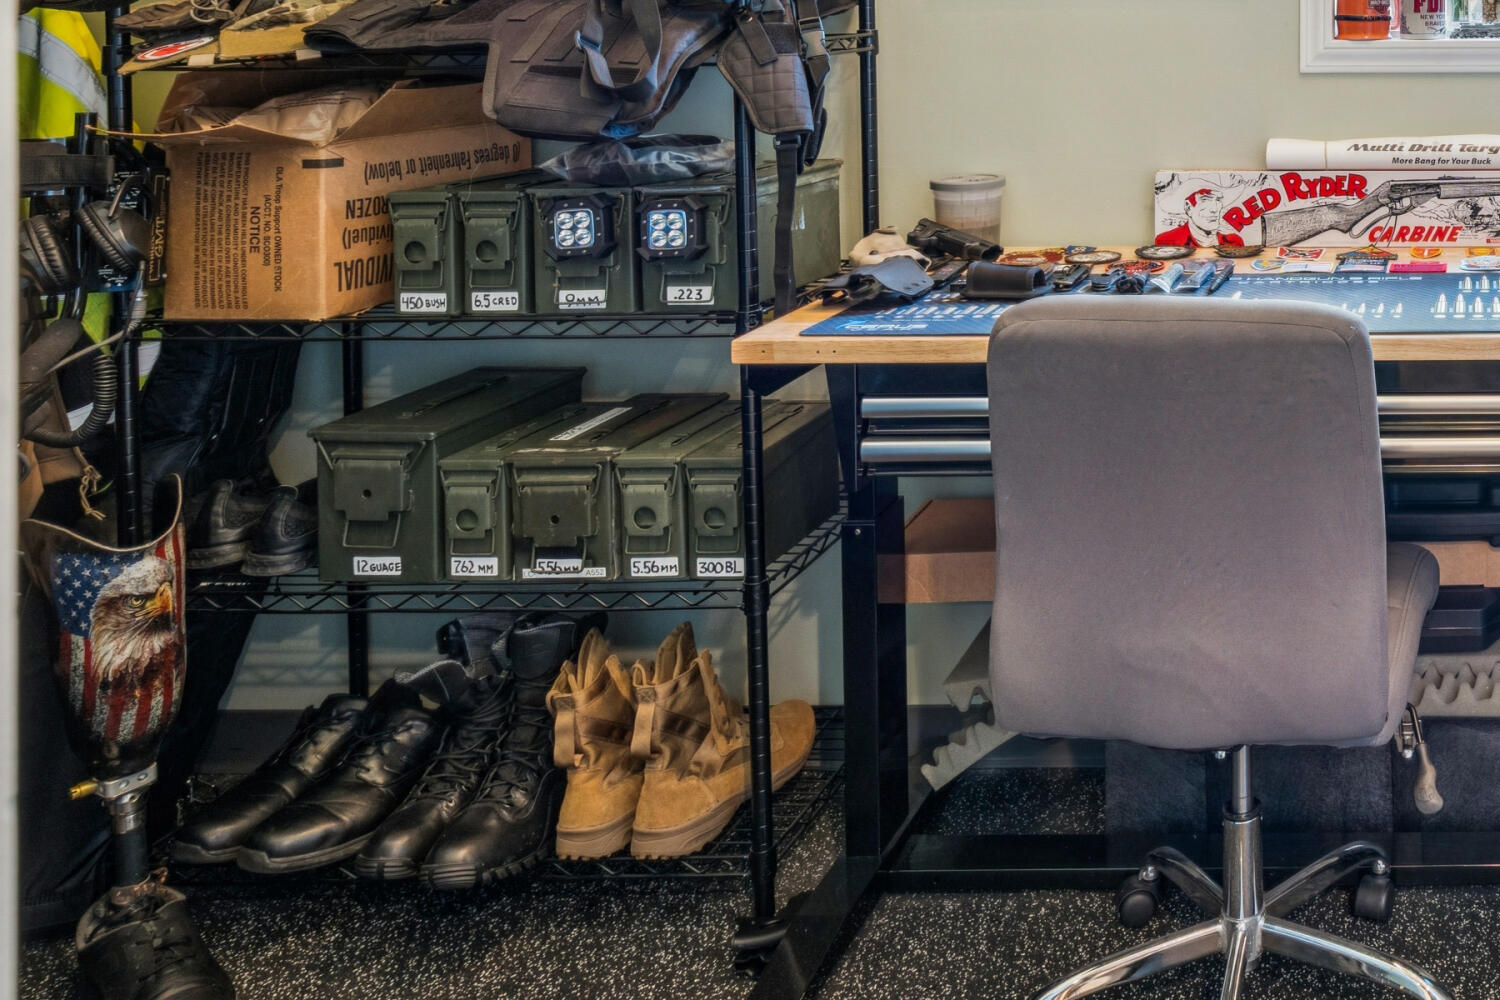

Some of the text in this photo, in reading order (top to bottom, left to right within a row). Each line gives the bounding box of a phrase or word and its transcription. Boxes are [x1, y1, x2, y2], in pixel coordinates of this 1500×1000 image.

[473, 143, 510, 164] degrees
[1347, 143, 1404, 152] Multi
[1408, 143, 1453, 152] Drill
[405, 162, 416, 175] or
[420, 150, 471, 176] Fahrenheit
[1415, 157, 1436, 165] Bang
[364, 161, 402, 185] below)
[274, 184, 283, 204] Troop
[1223, 172, 1368, 232] RED RYDER
[263, 194, 271, 233] (ACCT. NO.
[274, 205, 282, 234] Support
[155, 216, 165, 258] GMT
[250, 206, 260, 254] NOTICE
[1368, 225, 1463, 243] CARBINE
[274, 236, 282, 264] OWNED
[274, 266, 282, 292] STOCK
[402, 296, 446, 309] 450 BUSH
[474, 293, 517, 308] 6.5 CRED
[673, 288, 703, 300] .223
[356, 559, 402, 572] 12 GUAGE
